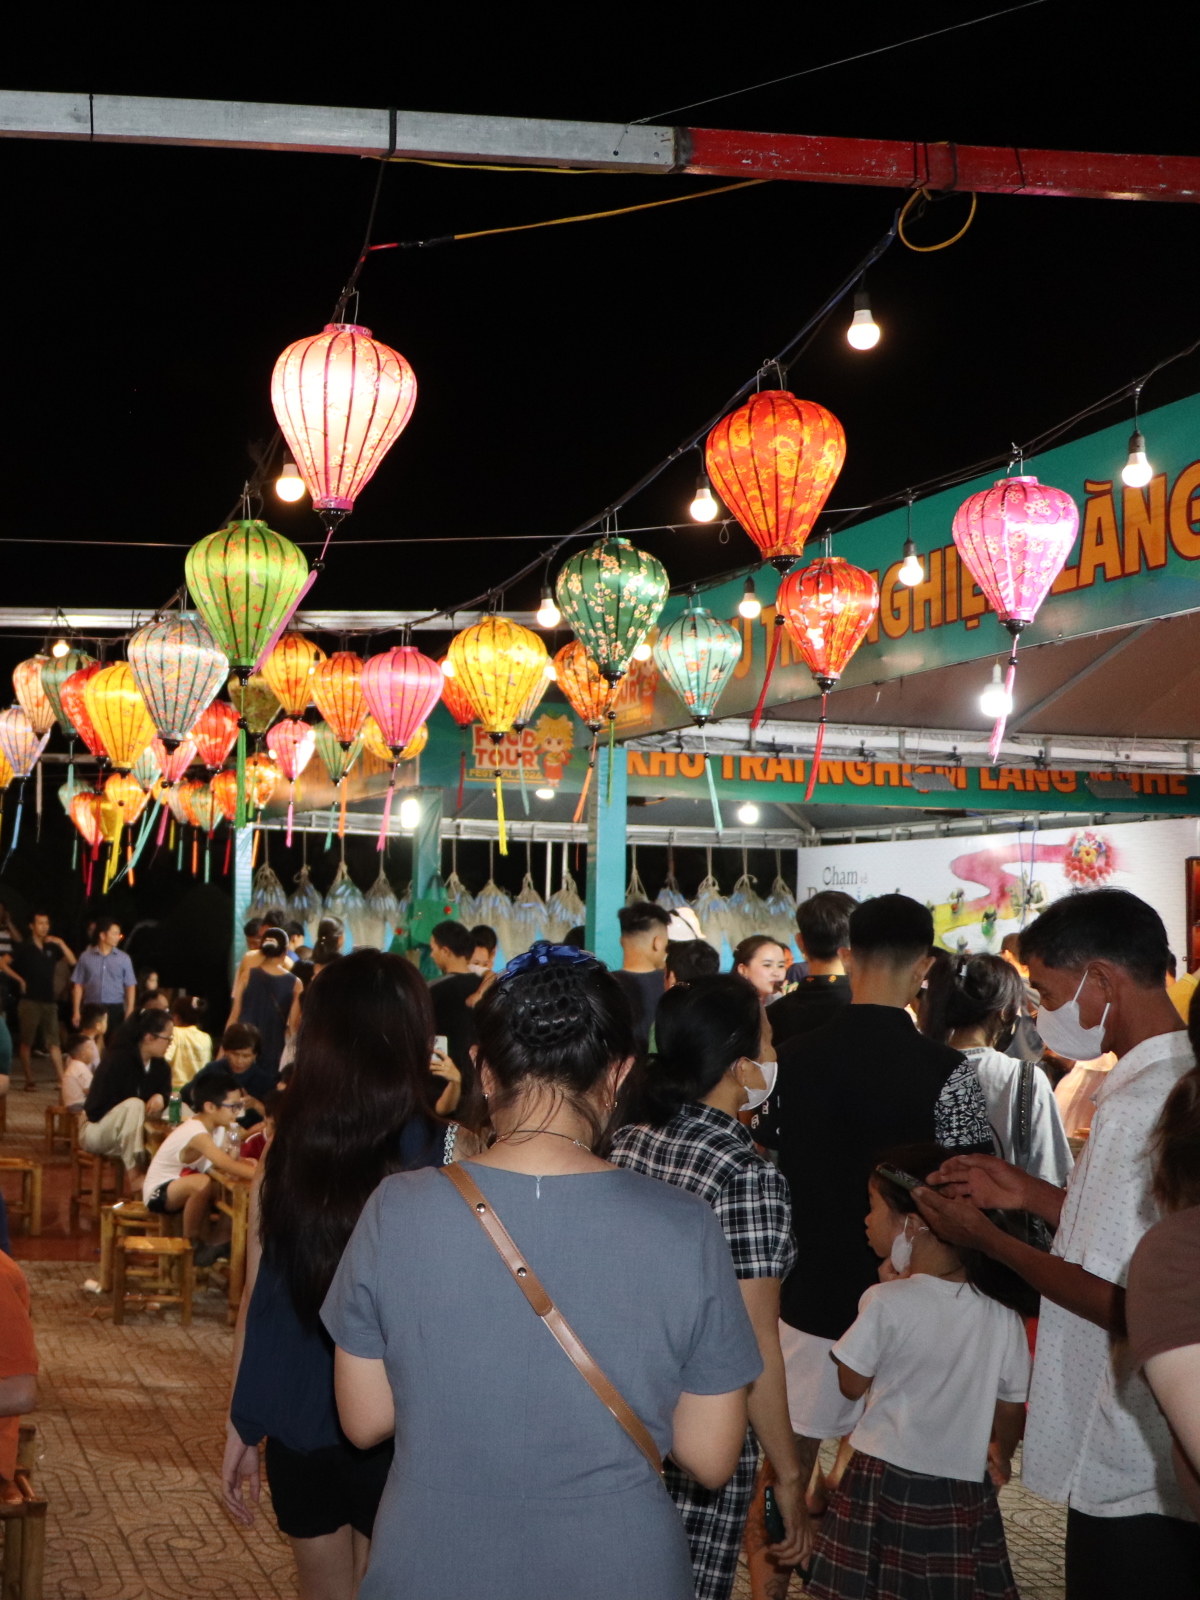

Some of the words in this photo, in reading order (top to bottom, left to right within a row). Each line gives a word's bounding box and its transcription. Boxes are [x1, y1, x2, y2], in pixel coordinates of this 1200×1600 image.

[475, 725, 536, 748] FOD
[475, 748, 535, 767] TOUR
[469, 768, 514, 779] FESTAL
